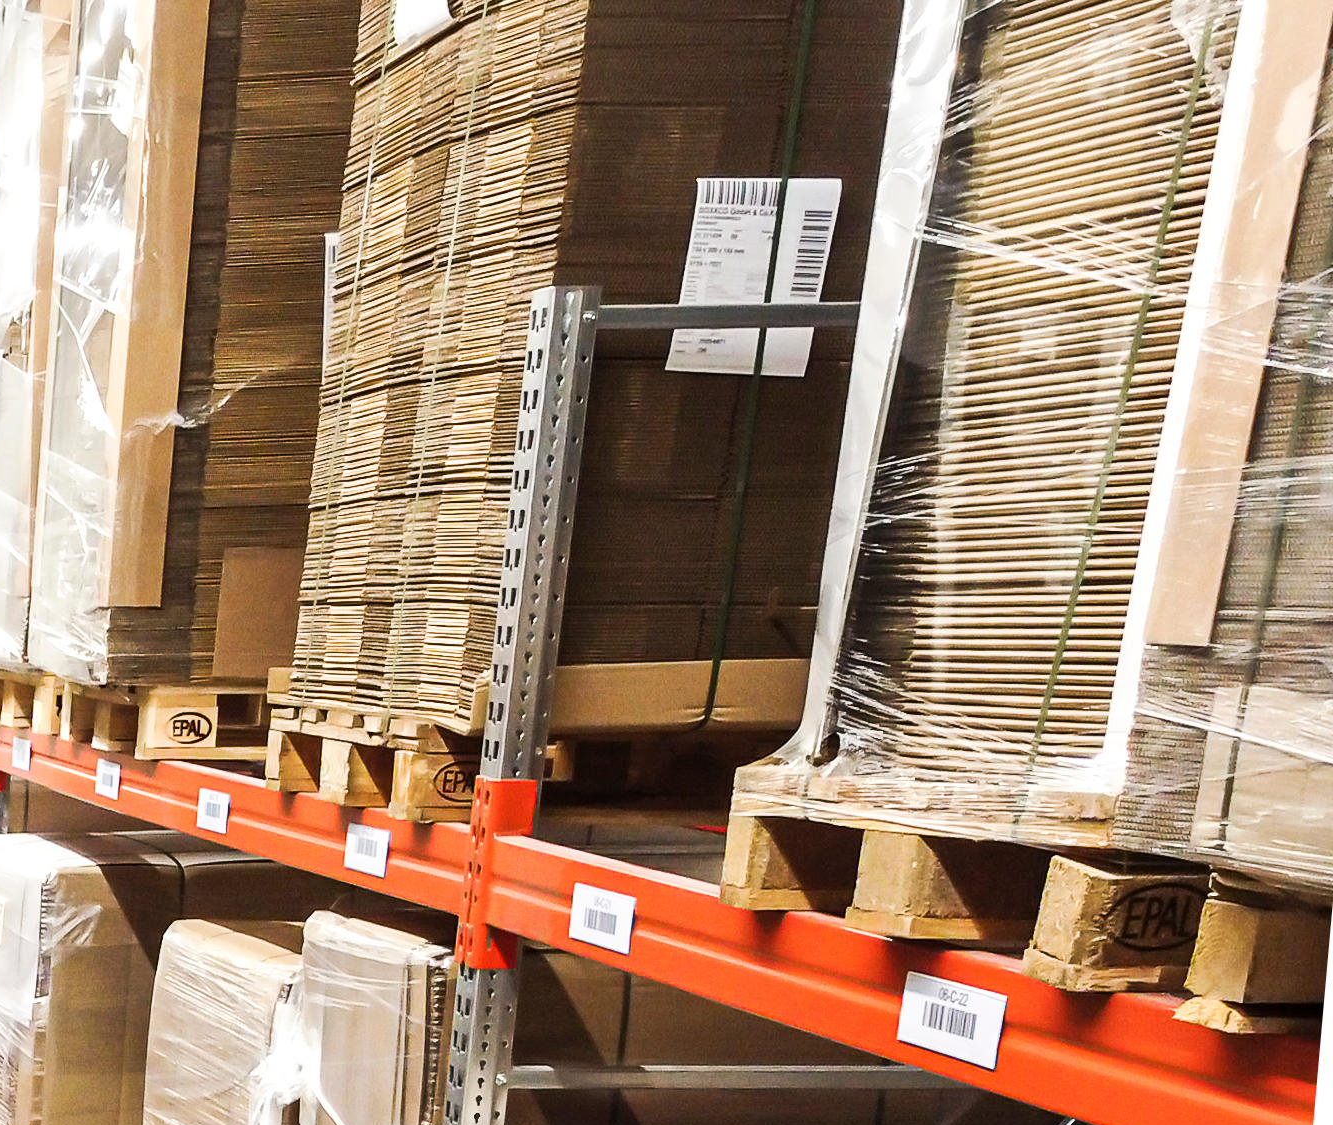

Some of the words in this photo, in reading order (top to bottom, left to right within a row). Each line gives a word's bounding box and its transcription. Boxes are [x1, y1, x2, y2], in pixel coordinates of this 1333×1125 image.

[173, 719, 206, 738] EPAL
[442, 770, 475, 794] EPA
[1121, 895, 1194, 939] EPAL
[938, 986, 969, 1007] 06-C-22
